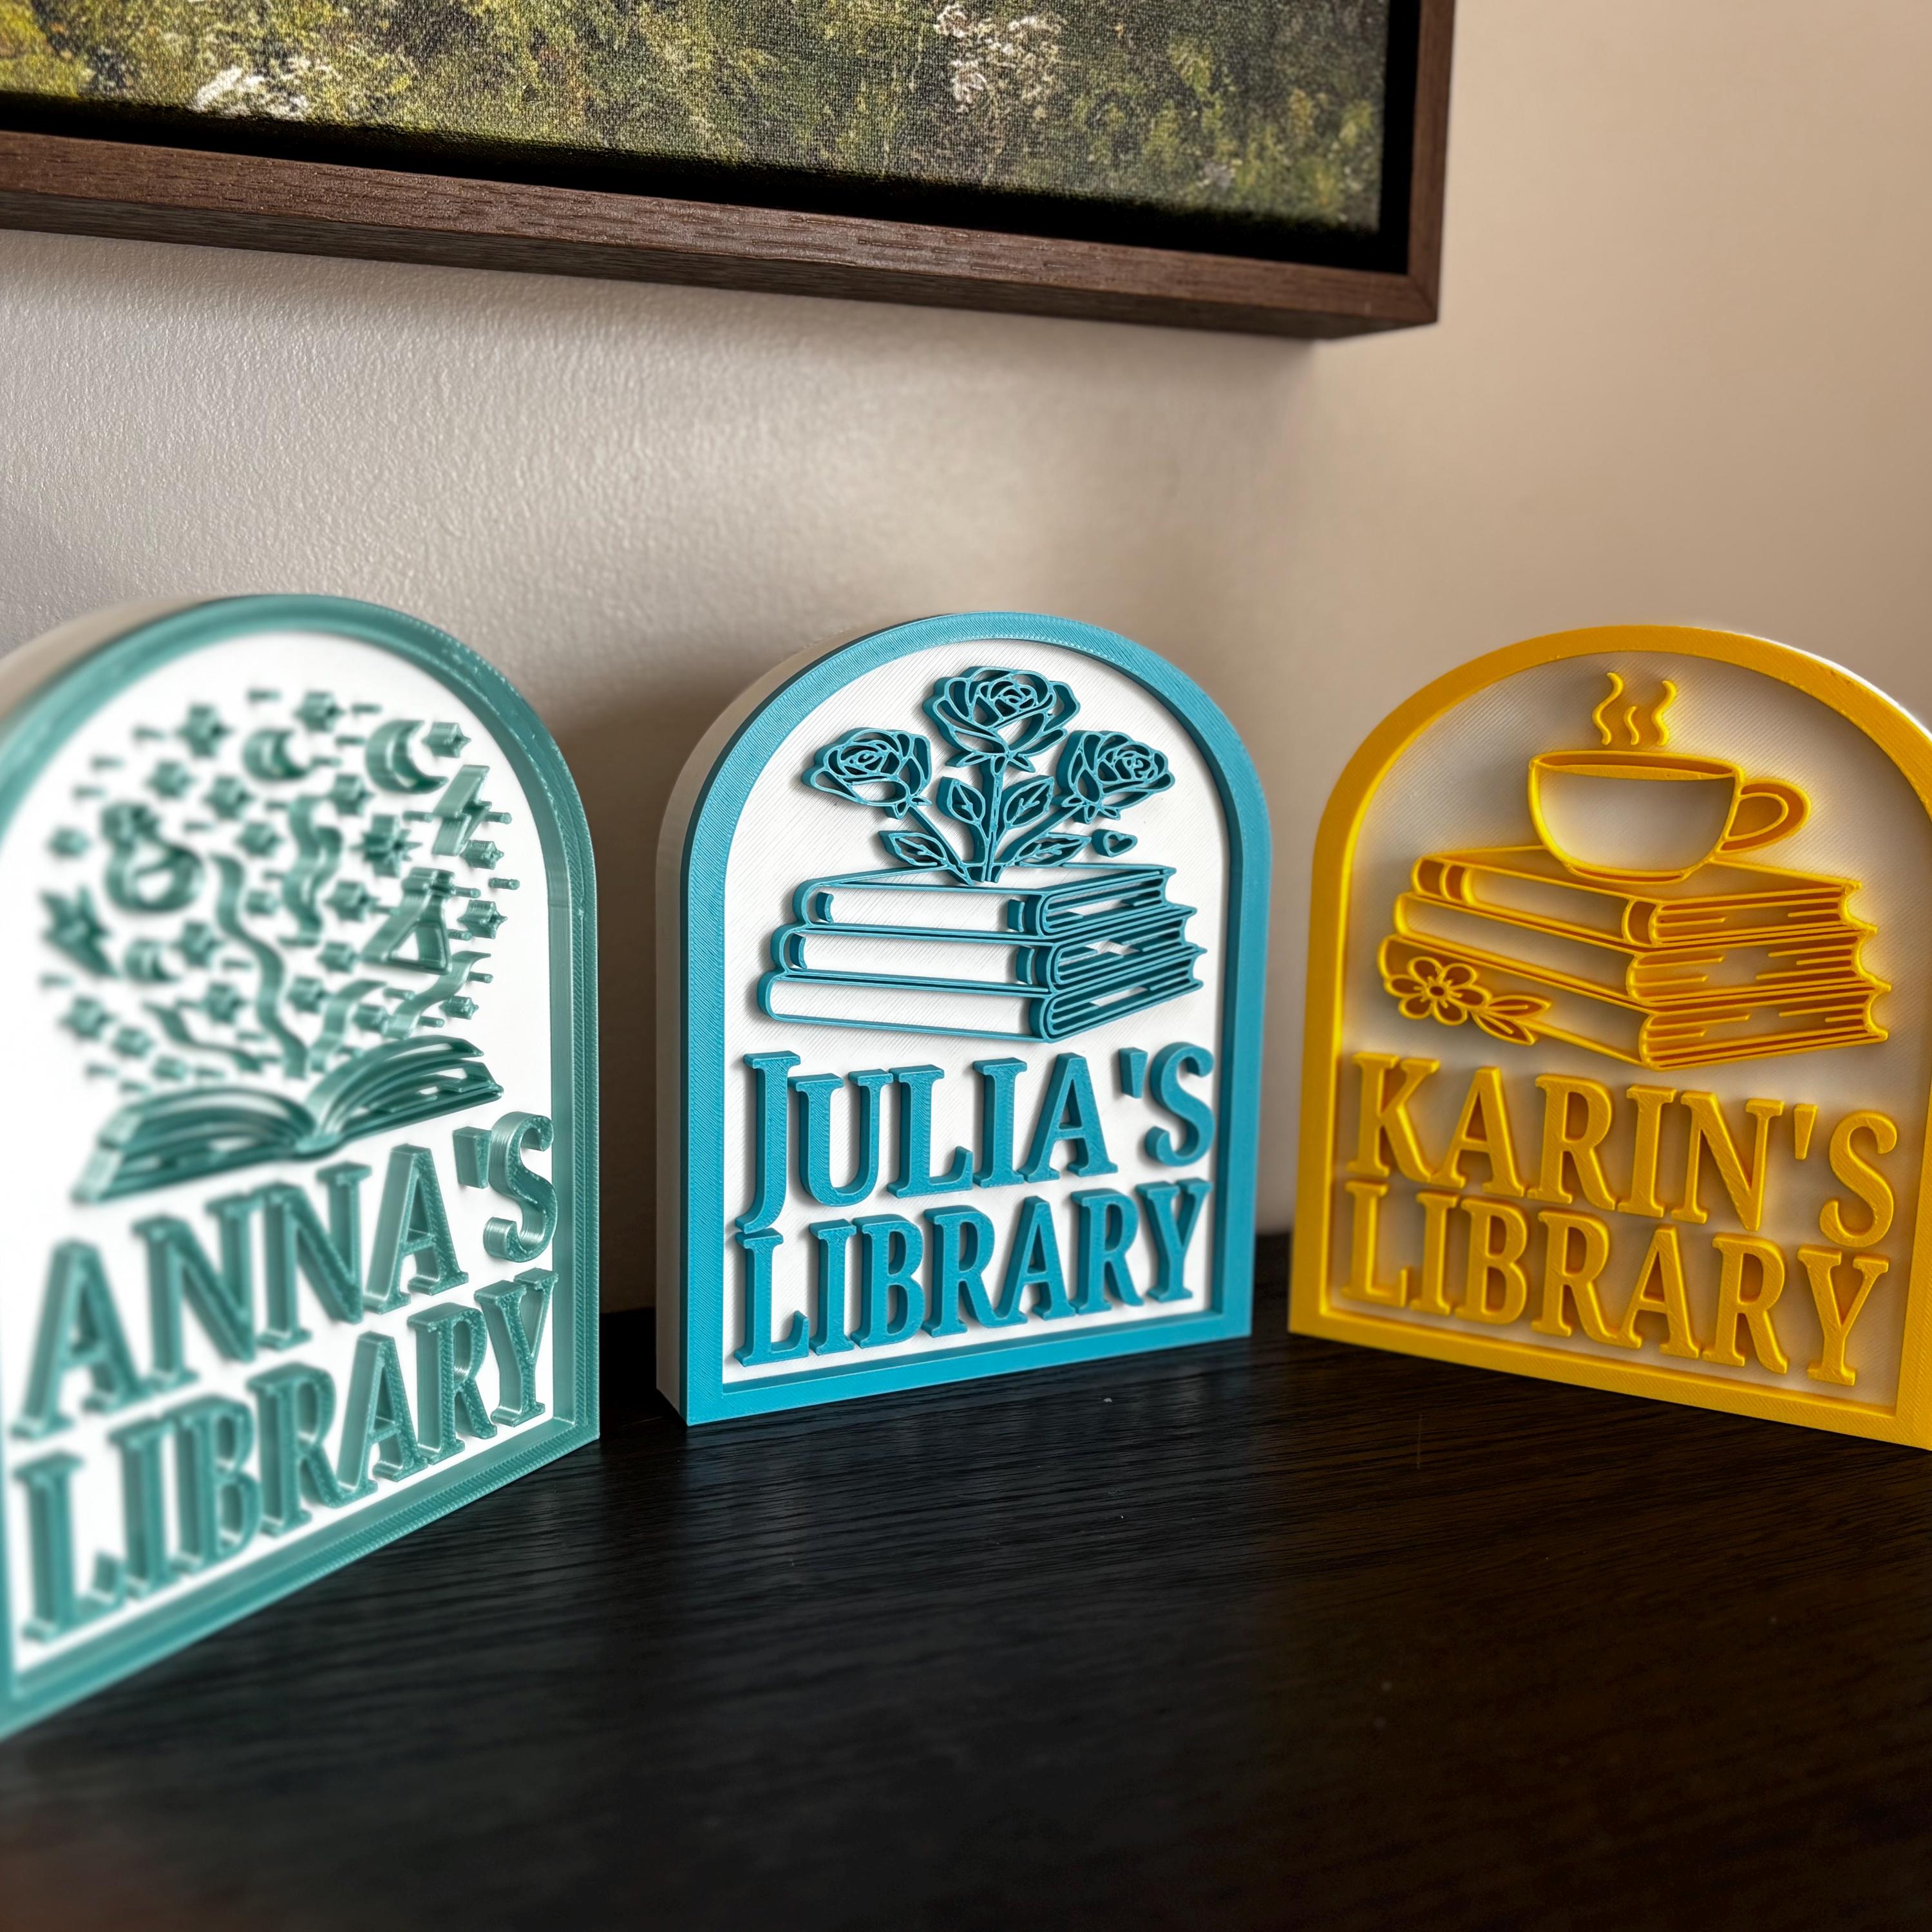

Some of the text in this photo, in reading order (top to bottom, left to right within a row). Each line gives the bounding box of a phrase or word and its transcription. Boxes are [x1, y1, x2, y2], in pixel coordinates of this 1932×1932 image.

[735, 1041, 1216, 1235] JULIA'S
[1346, 1052, 1898, 1248] KARIN'S
[10, 1111, 558, 1441] ANNA'S
[734, 1178, 1213, 1367] LIBRARY
[1341, 1179, 1889, 1386] LIBRARY
[12, 1267, 559, 1643] LIBRARY
